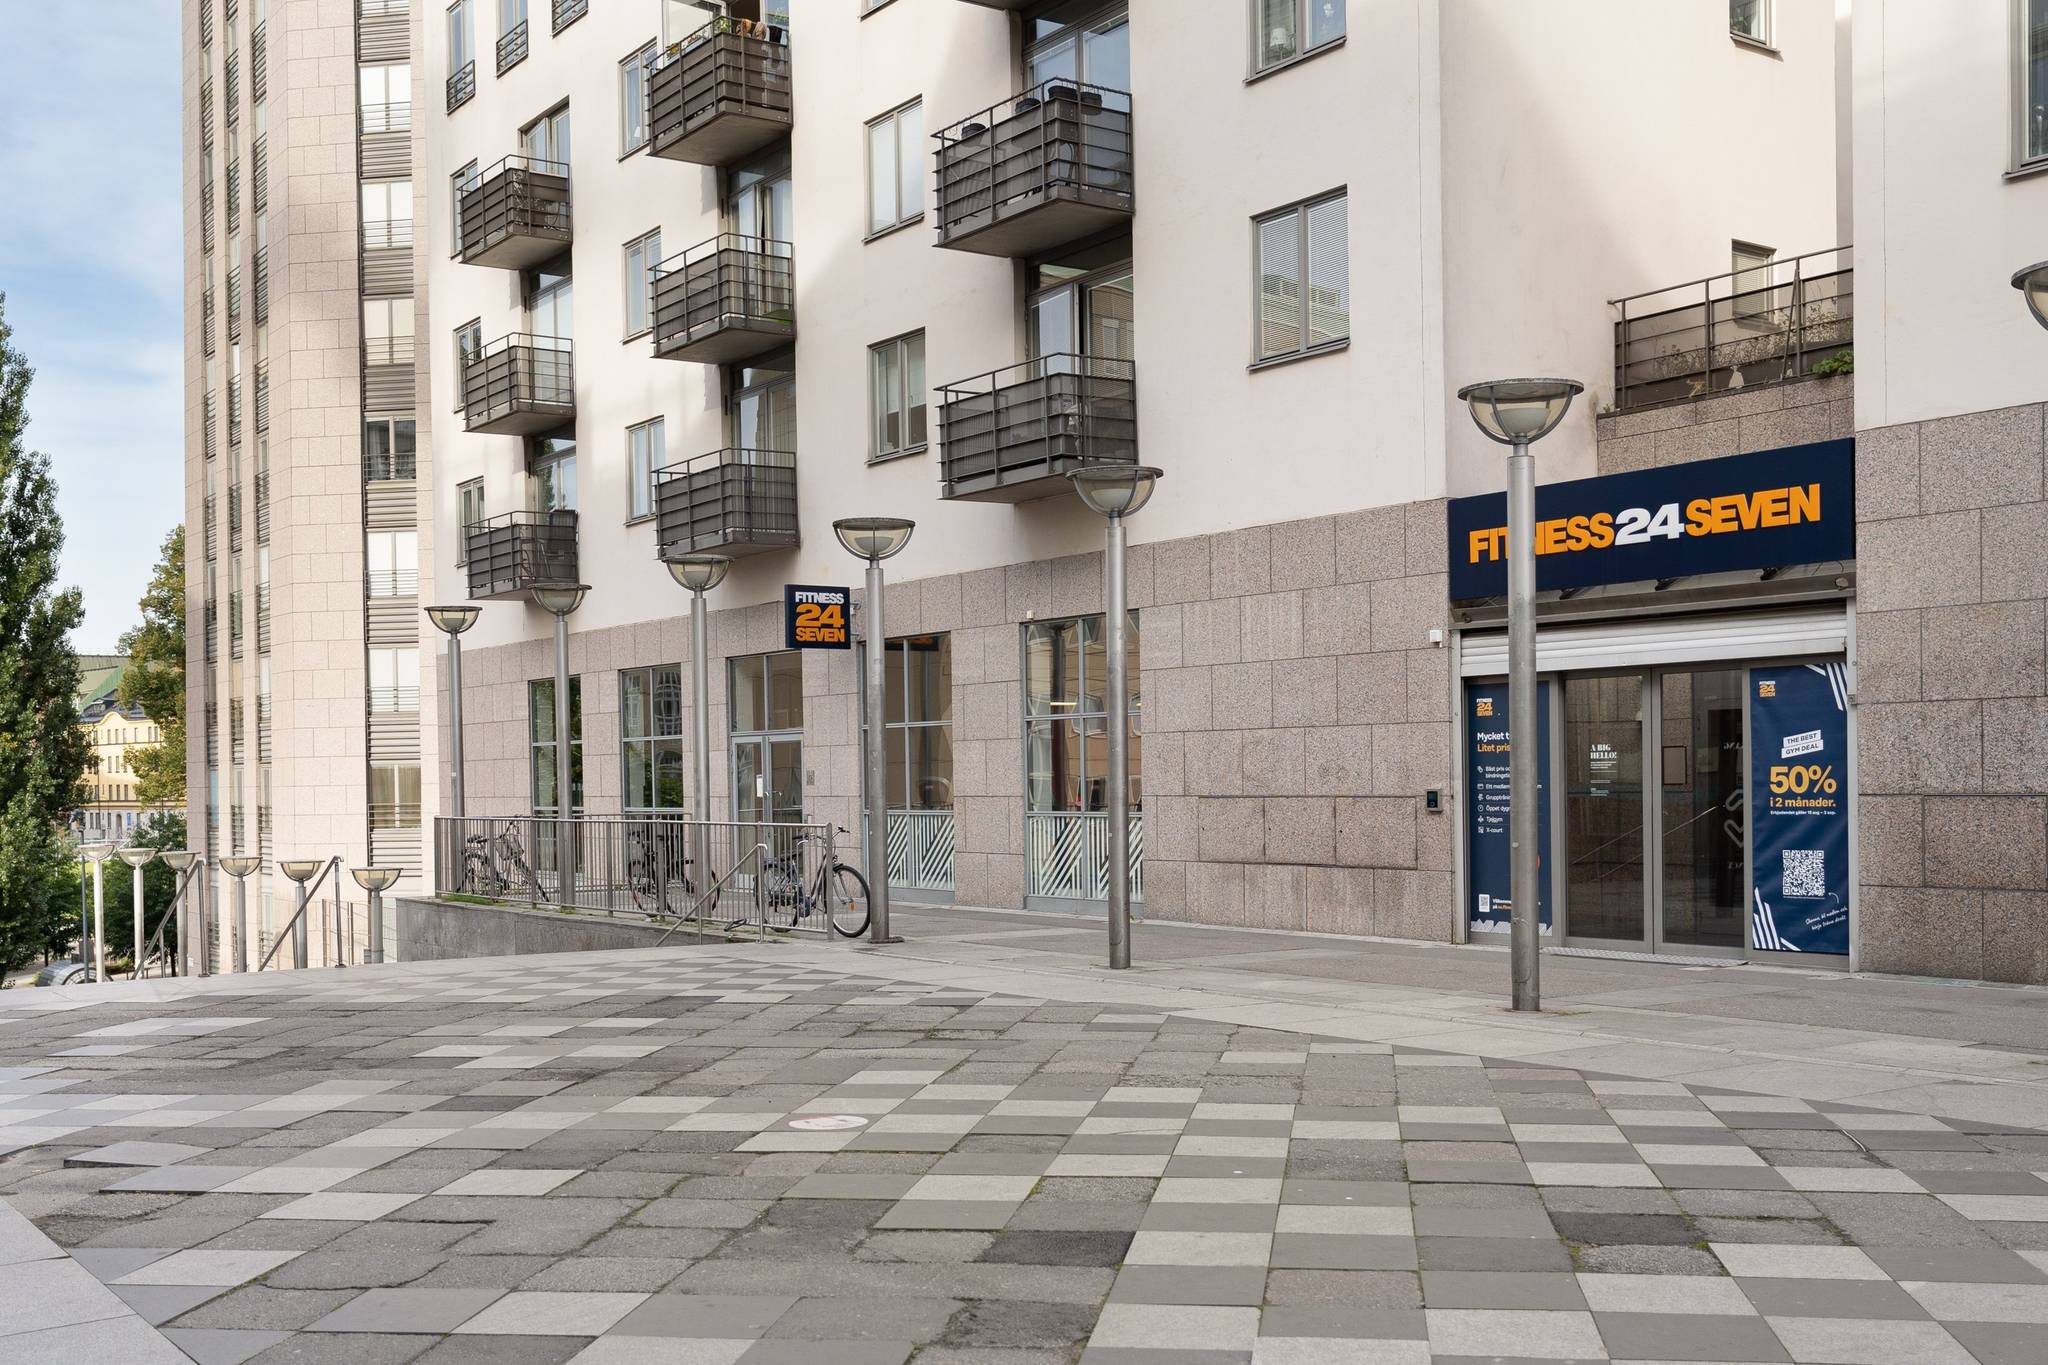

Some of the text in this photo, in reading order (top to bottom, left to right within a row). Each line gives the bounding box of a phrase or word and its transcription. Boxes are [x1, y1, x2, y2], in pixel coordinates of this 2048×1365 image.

[795, 592, 844, 604] FITNESS
[796, 603, 844, 627] 24
[796, 627, 845, 642] SEVEN
[1760, 684, 1775, 692] 24
[1477, 702, 1492, 712] 24
[1477, 732, 1504, 742] Mycket
[1800, 733, 1817, 741] BEST
[1477, 744, 1495, 752] Litet
[1597, 743, 1611, 751] BIG
[1801, 743, 1819, 751] DEAL
[1590, 751, 1617, 759] HELLO!
[1769, 765, 1837, 794] 50%
[1770, 796, 1836, 807] i 2 månader.
